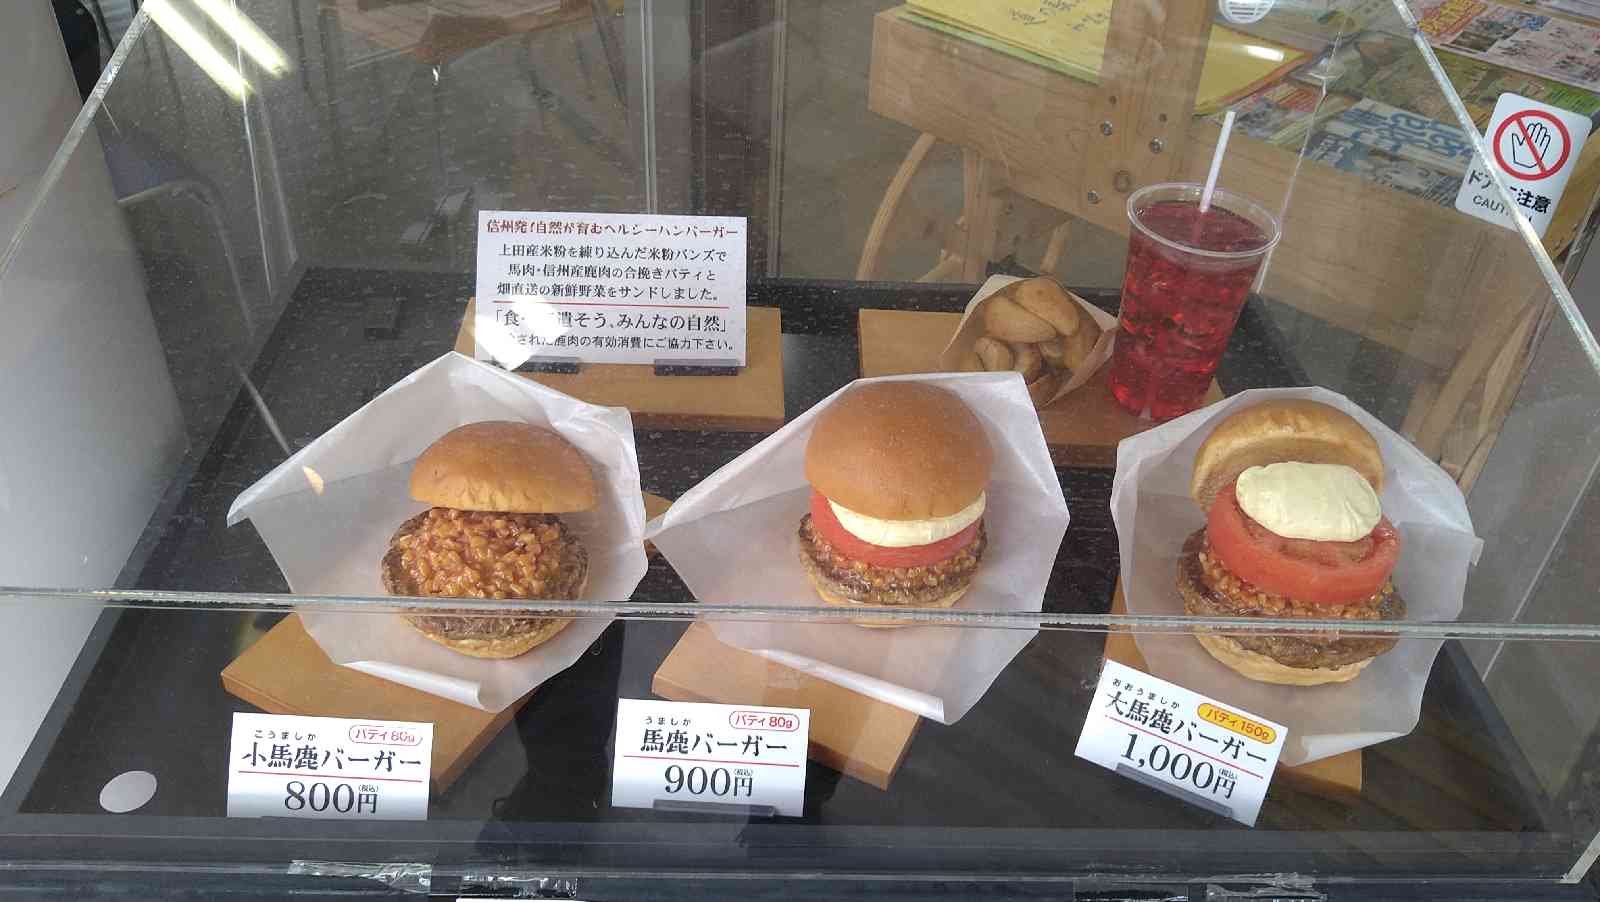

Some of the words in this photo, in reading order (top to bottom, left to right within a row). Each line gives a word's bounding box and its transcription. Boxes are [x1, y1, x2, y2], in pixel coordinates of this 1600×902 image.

[496, 282, 719, 302] 畑直送の新鮮野菜をサンドしました。
[1112, 677, 1180, 709] おおうましか
[254, 729, 317, 742] こうましか
[643, 715, 692, 727] うましか
[1104, 690, 1268, 763] 大馬鹿バーガー
[241, 741, 422, 773] 小馬鹿バーガー
[640, 728, 788, 757] 馬鹿バーガー
[664, 764, 753, 797] 900円
[1120, 732, 1237, 799] 1,000円
[284, 780, 379, 814] 800円
